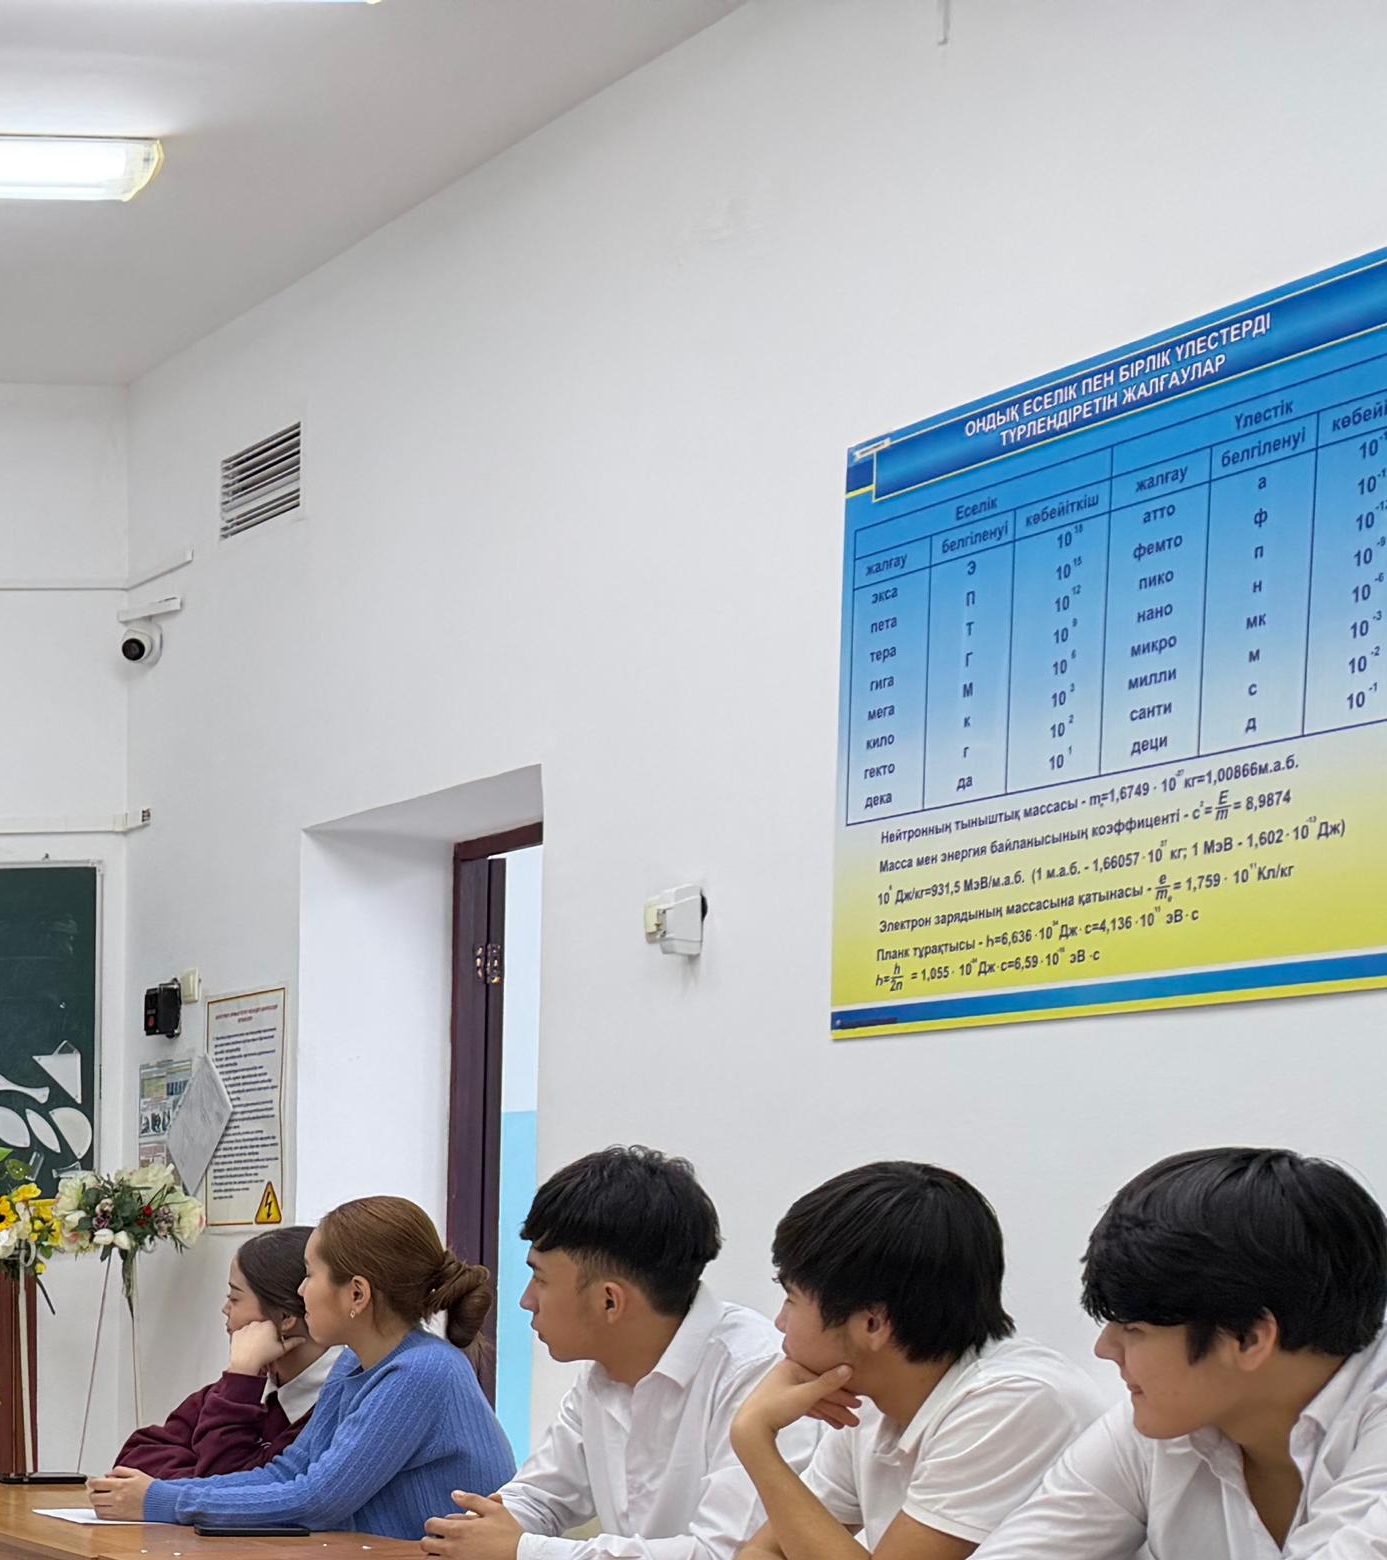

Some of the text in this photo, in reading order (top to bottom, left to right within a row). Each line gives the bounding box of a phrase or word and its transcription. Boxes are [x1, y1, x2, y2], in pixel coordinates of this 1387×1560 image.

[965, 313, 1271, 437] ОНДЫҚ ЕСЕЛІК ПЕН БІРЛІК ҮЛЕСТЕРДІ
[1000, 354, 1226, 446] ТҮРЛЕНДІРЕТІН ЖАЛҒАУЛАР
[1235, 400, 1293, 430] Үлестік
[1222, 427, 1306, 468] белгіленуі
[955, 500, 998, 521] Еселік
[1026, 494, 1099, 527] көбейіткіш
[1143, 504, 1176, 523] атто
[942, 521, 1008, 554] белгіленуі
[1133, 534, 1183, 562] фемто
[1139, 570, 1174, 591] пико
[871, 586, 898, 604] экса
[870, 615, 898, 633] пета
[1137, 603, 1173, 624] нано
[1246, 613, 1266, 630] мк
[870, 646, 897, 663] тера
[1130, 635, 1177, 658] микро
[870, 674, 894, 692] гига
[1128, 668, 1177, 691] милли
[867, 704, 895, 721] мега
[1130, 701, 1173, 722] санти
[866, 733, 895, 750] кило
[1130, 735, 1168, 757] деци
[864, 762, 895, 780] гекто
[956, 775, 973, 792] да
[864, 791, 892, 810] дека
[1245, 789, 1292, 812] 8,9874
[881, 818, 952, 844] Нейтронның
[955, 809, 1020, 832] тыныштық
[1023, 797, 1078, 818] массасы
[879, 855, 913, 873] Масса
[916, 853, 938, 867] мен
[941, 845, 987, 866] энергия
[990, 825, 1089, 854] байланысының
[1091, 809, 1181, 839] коэффиценті
[1092, 852, 1140, 874] 1,66057
[1246, 829, 1283, 849] 1,602
[1185, 872, 1221, 893] 1,759
[879, 912, 932, 934] Электрон
[934, 904, 1003, 927] зарядының
[1006, 896, 1075, 916] массасына
[1078, 884, 1143, 905] қатынасы
[877, 946, 910, 962] Планк
